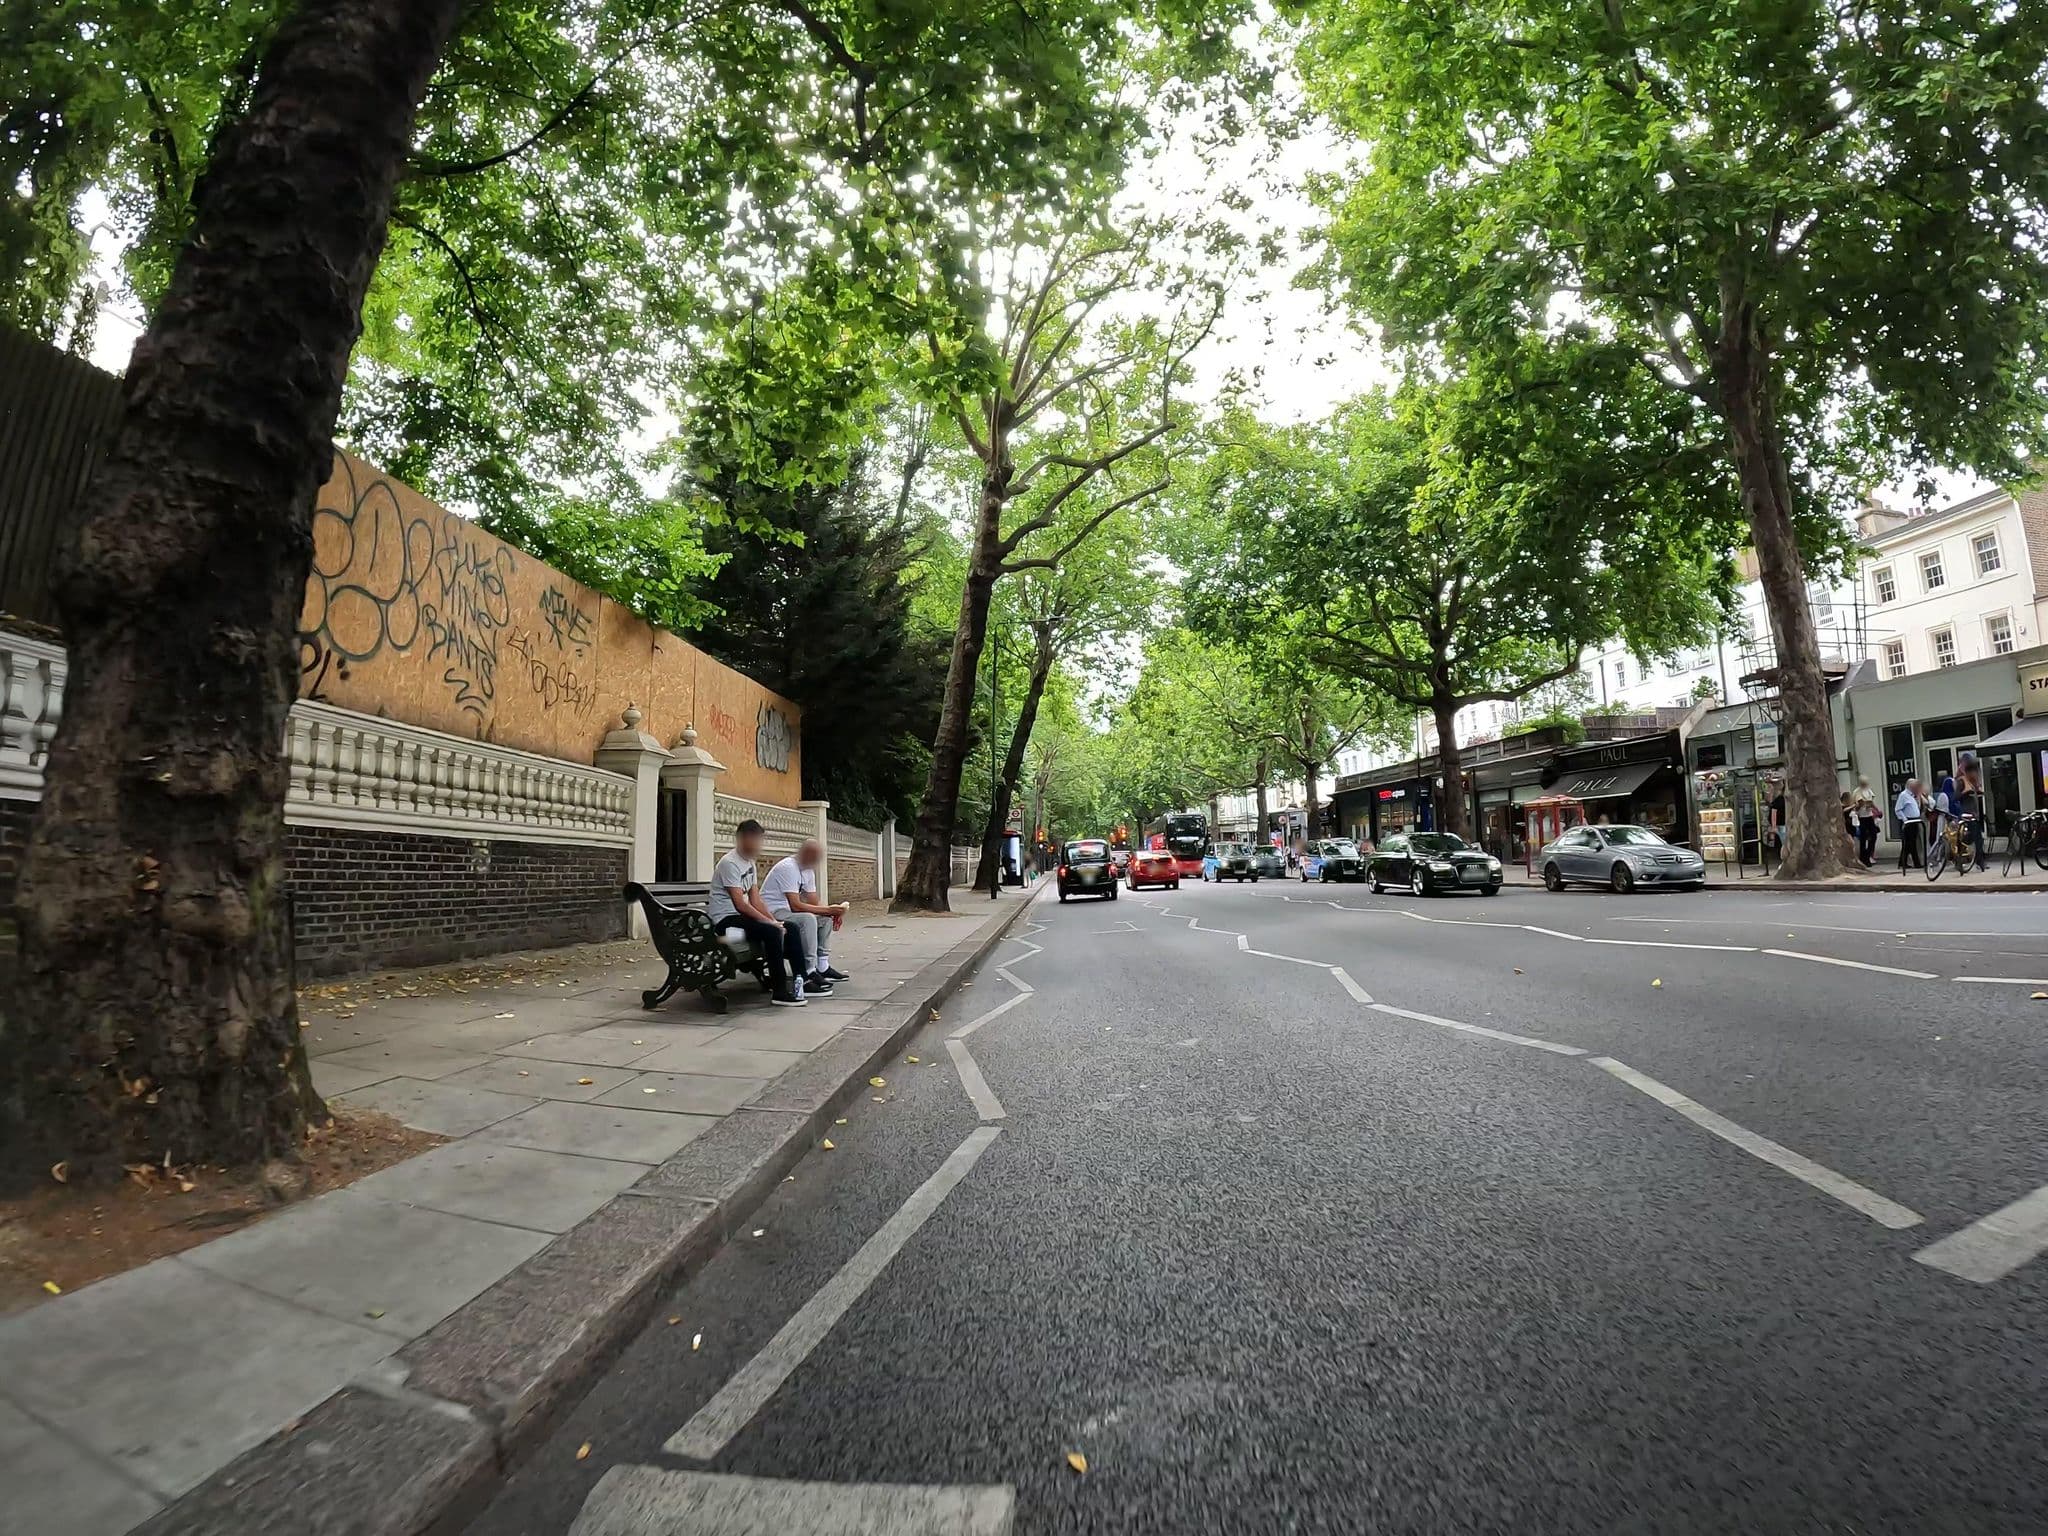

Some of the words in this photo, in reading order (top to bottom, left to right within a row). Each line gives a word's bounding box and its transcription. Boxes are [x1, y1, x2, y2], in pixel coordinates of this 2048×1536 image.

[1600, 746, 1627, 763] PAUL
[1888, 760, 1899, 775] TO
[1900, 758, 1914, 774] LET
[1567, 776, 1617, 793] PAUL
